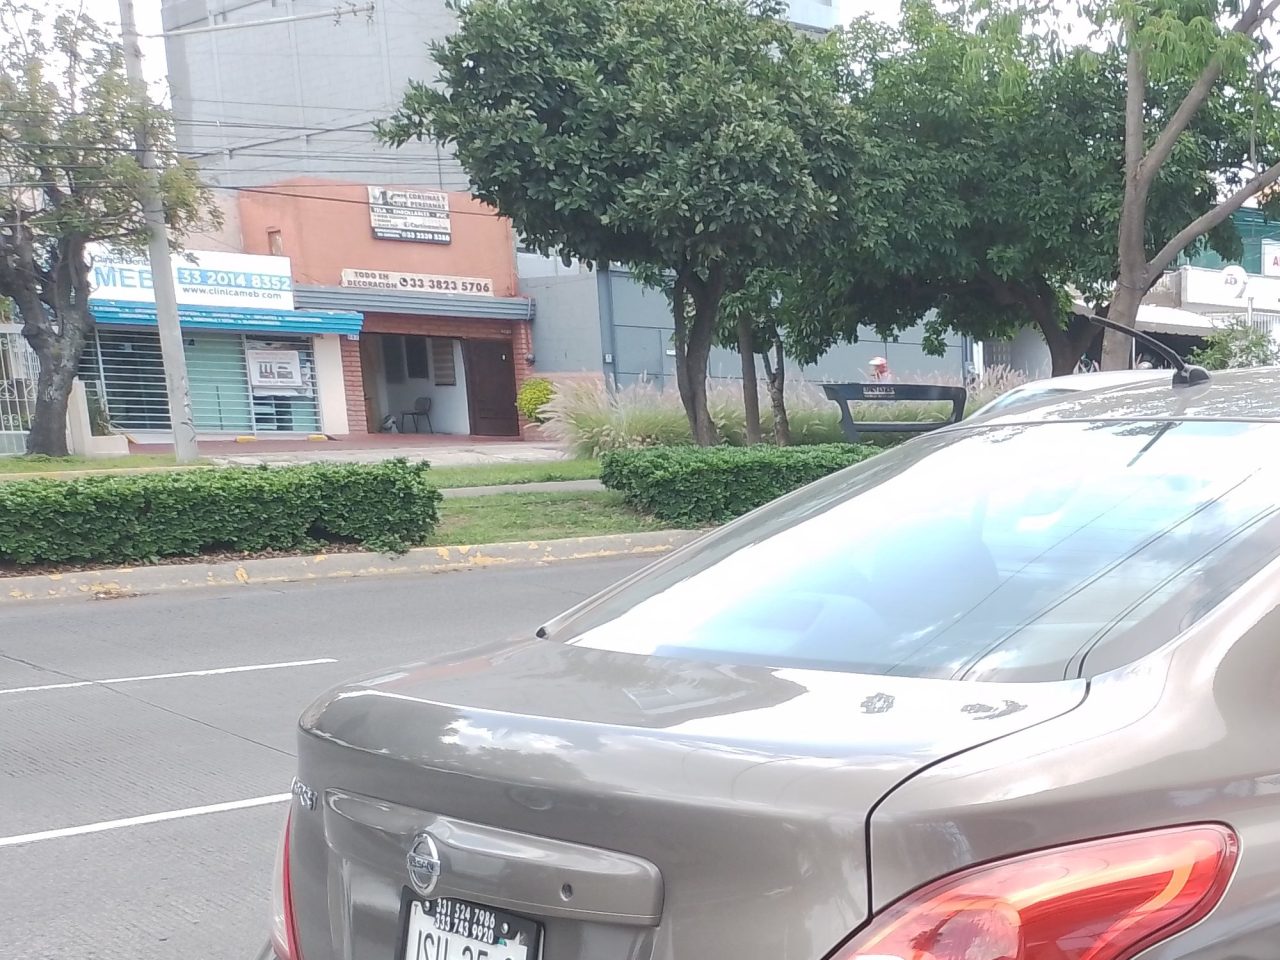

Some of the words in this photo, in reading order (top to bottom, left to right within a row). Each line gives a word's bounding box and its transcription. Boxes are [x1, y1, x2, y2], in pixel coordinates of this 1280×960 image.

[182, 270, 201, 284] 33
[207, 272, 246, 287] 2014
[251, 275, 291, 290] 8352
[354, 271, 377, 279] TODO
[182, 287, 282, 299] www.clinicameb.com
[409, 278, 424, 289] 33
[428, 279, 458, 291] 3823
[461, 282, 490, 292] 5706
[436, 898, 452, 915] 331
[455, 903, 471, 920] 524
[474, 908, 496, 927] 7986
[434, 914, 451, 931] 333
[453, 919, 469, 936] 743
[472, 924, 494, 943] 9920
